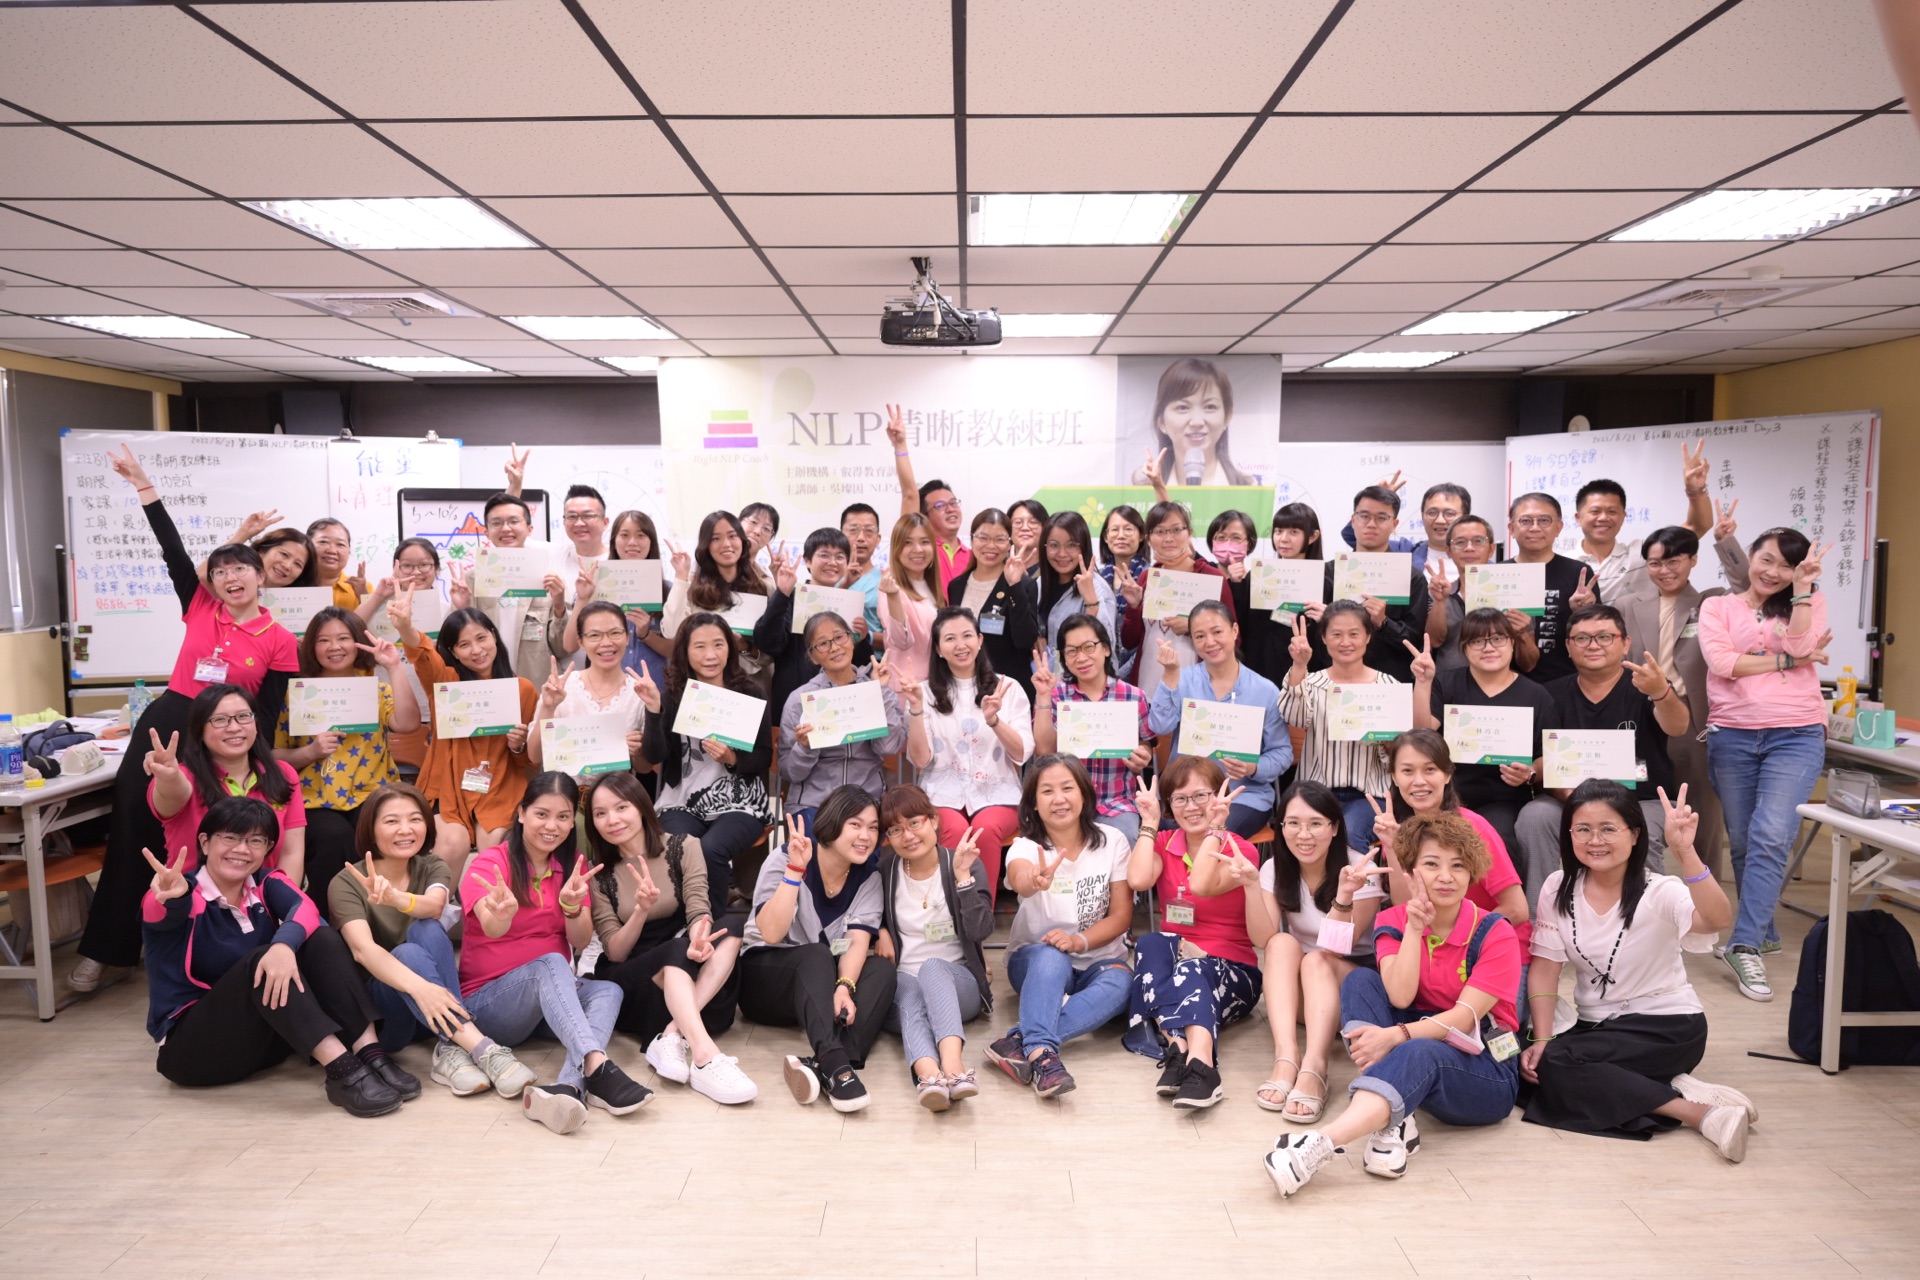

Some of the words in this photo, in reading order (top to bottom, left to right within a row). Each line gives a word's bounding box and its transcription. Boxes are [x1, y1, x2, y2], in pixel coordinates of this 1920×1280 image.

[693, 454, 718, 466] Right
[720, 454, 740, 464] NLP
[742, 452, 769, 463] Coach
[1075, 872, 1107, 892] TODAY
[1076, 885, 1096, 900] NOT
